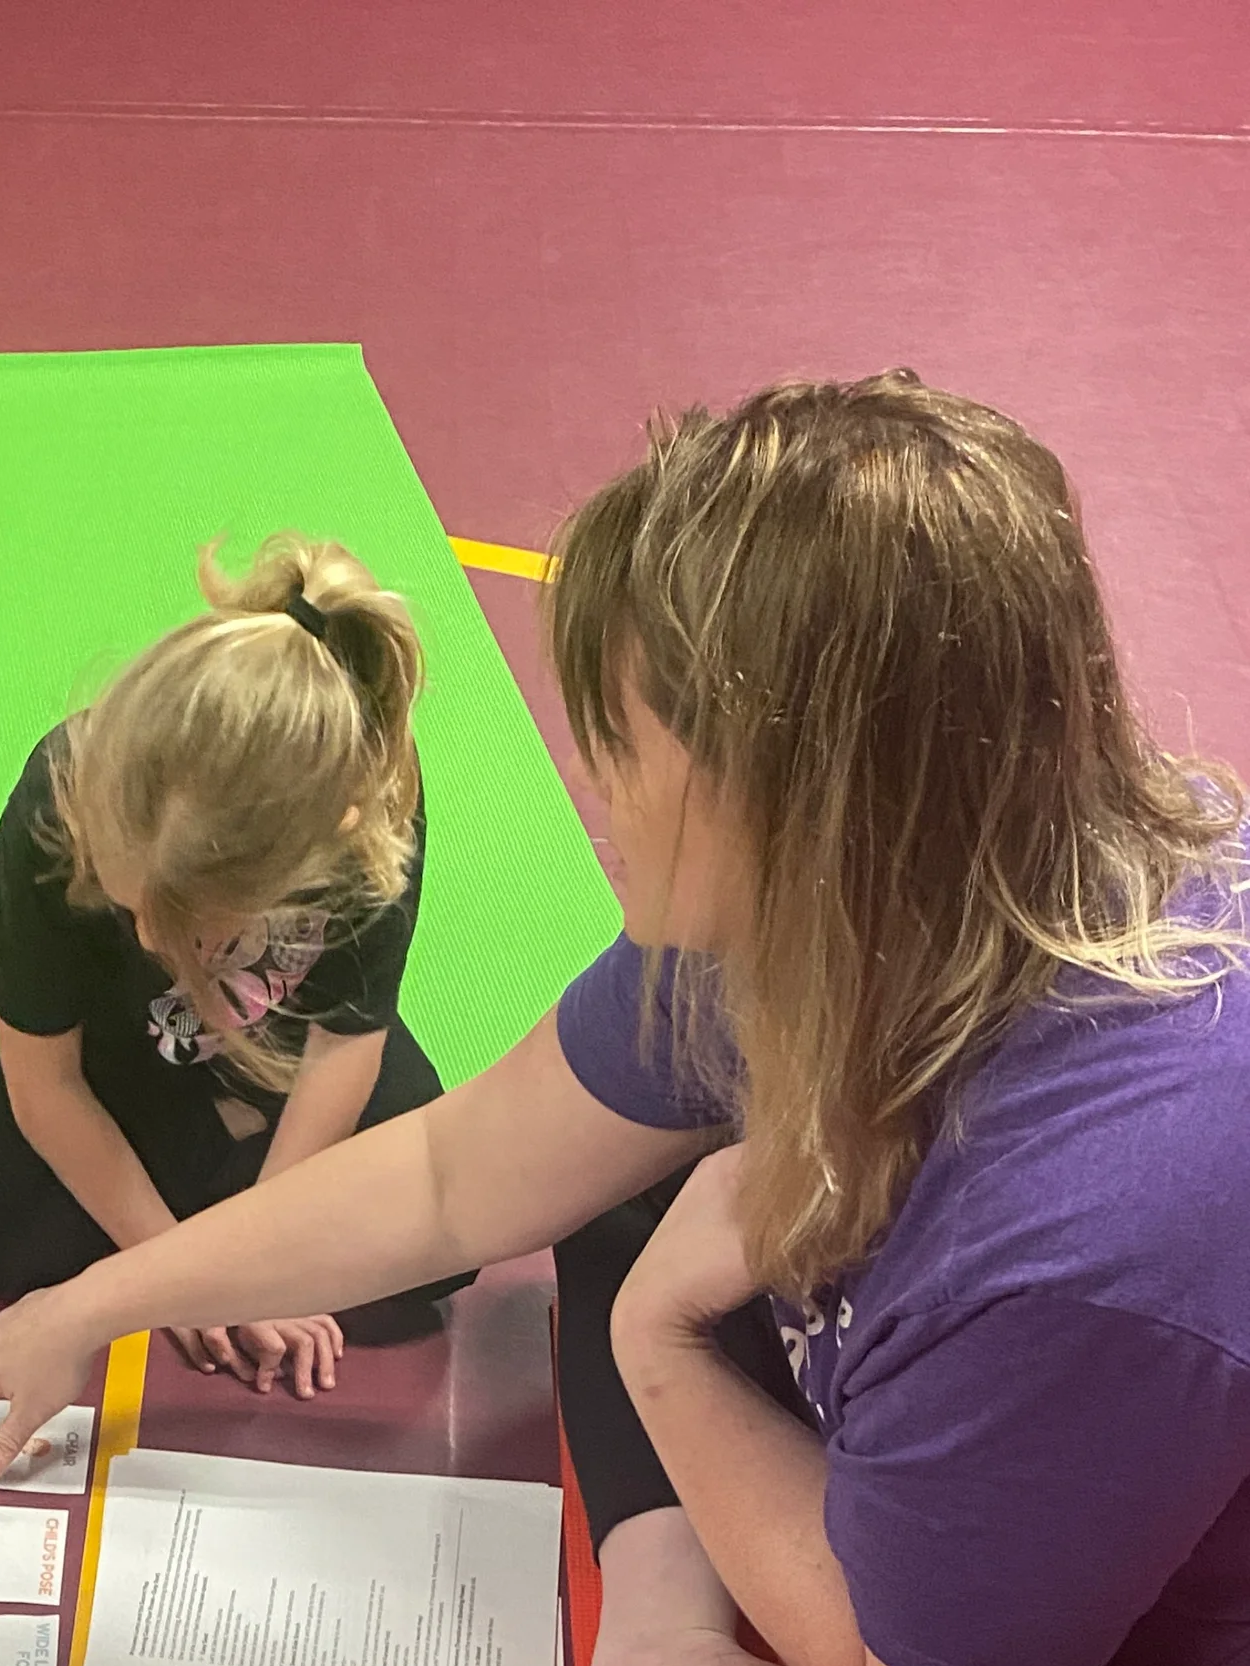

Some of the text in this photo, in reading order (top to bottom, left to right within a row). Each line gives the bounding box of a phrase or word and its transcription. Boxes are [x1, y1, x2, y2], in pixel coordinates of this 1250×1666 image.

[63, 1431, 79, 1467] CHAIR
[38, 1564, 55, 1596] POSE
[35, 1623, 50, 1657] WIDE
